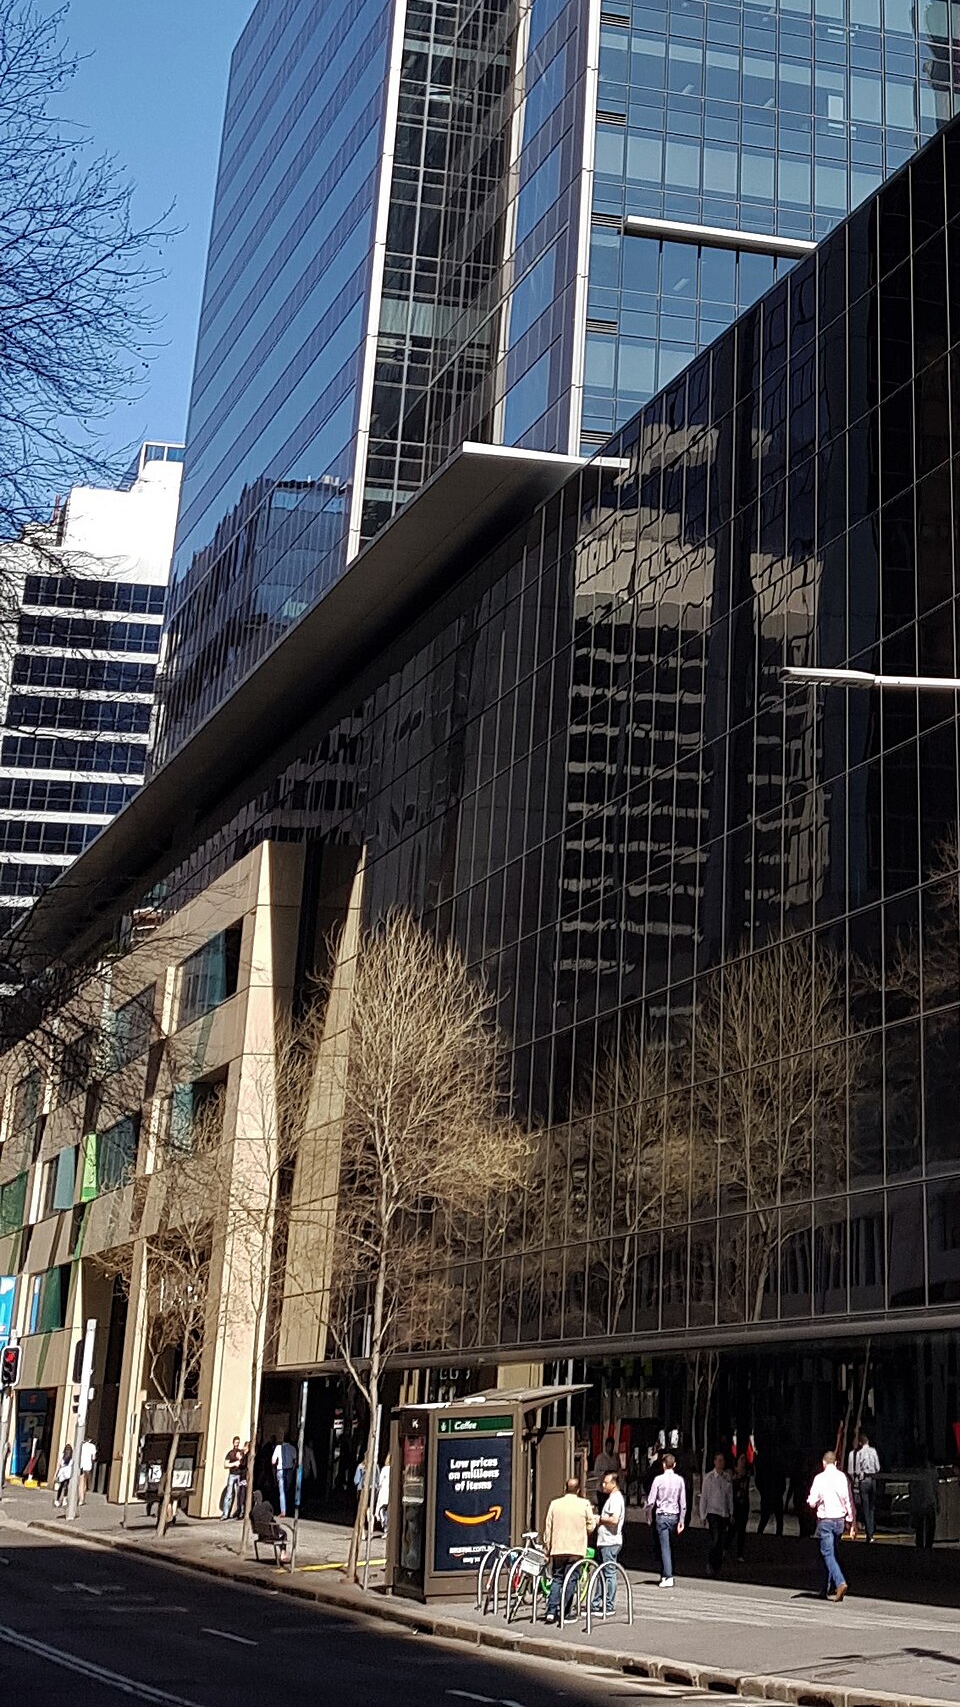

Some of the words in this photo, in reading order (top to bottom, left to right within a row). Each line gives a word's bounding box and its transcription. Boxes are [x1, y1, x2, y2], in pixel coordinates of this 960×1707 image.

[454, 1420, 478, 1430] Coffee
[450, 1459, 469, 1469] Low
[470, 1456, 498, 1472] prices
[448, 1472, 461, 1480] on
[462, 1469, 499, 1479] millions
[455, 1481, 465, 1491] of
[466, 1480, 492, 1490] items
